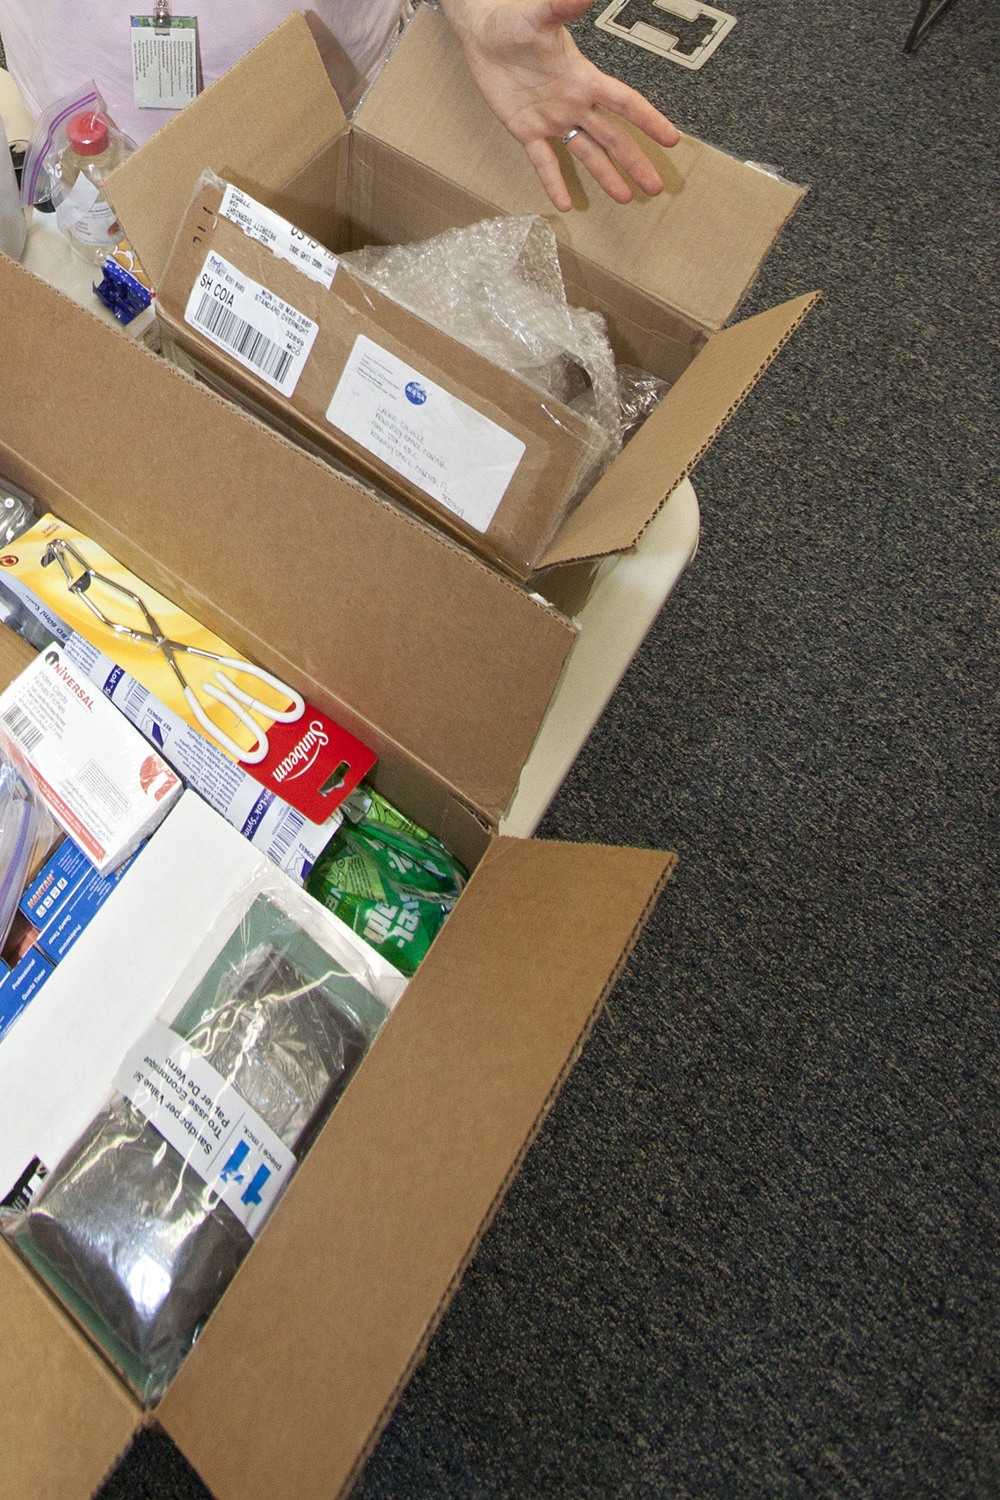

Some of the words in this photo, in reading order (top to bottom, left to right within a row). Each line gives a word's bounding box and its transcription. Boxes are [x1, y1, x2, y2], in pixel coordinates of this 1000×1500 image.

[226, 204, 253, 225] OVERNIGHT
[253, 225, 276, 241] PRIORITY
[200, 273, 213, 290] SH
[254, 293, 280, 315] STANDARD
[280, 312, 309, 335] OVERNIGHT
[261, 289, 272, 300] MON
[284, 306, 296, 316] MAR
[285, 329, 304, 346] 32899
[286, 342, 298, 354] MCO
[406, 385, 424, 401] NASA
[39, 610, 57, 627] 60ml
[33, 675, 65, 714] Fichas/Fiches
[38, 670, 52, 686] Index
[51, 685, 68, 704] Cards
[272, 719, 329, 784] Sunbeam
[57, 914, 71, 930] Quartz
[48, 930, 60, 945] Timer
[58, 924, 81, 954] Professional
[11, 958, 35, 989] Professional
[21, 982, 35, 1000] Quartz
[33, 968, 45, 983] Timer
[143, 1078, 164, 1104] Value
[187, 1080, 200, 1096] De
[188, 1098, 221, 1139] Trousse
[262, 1148, 282, 1171] piece
